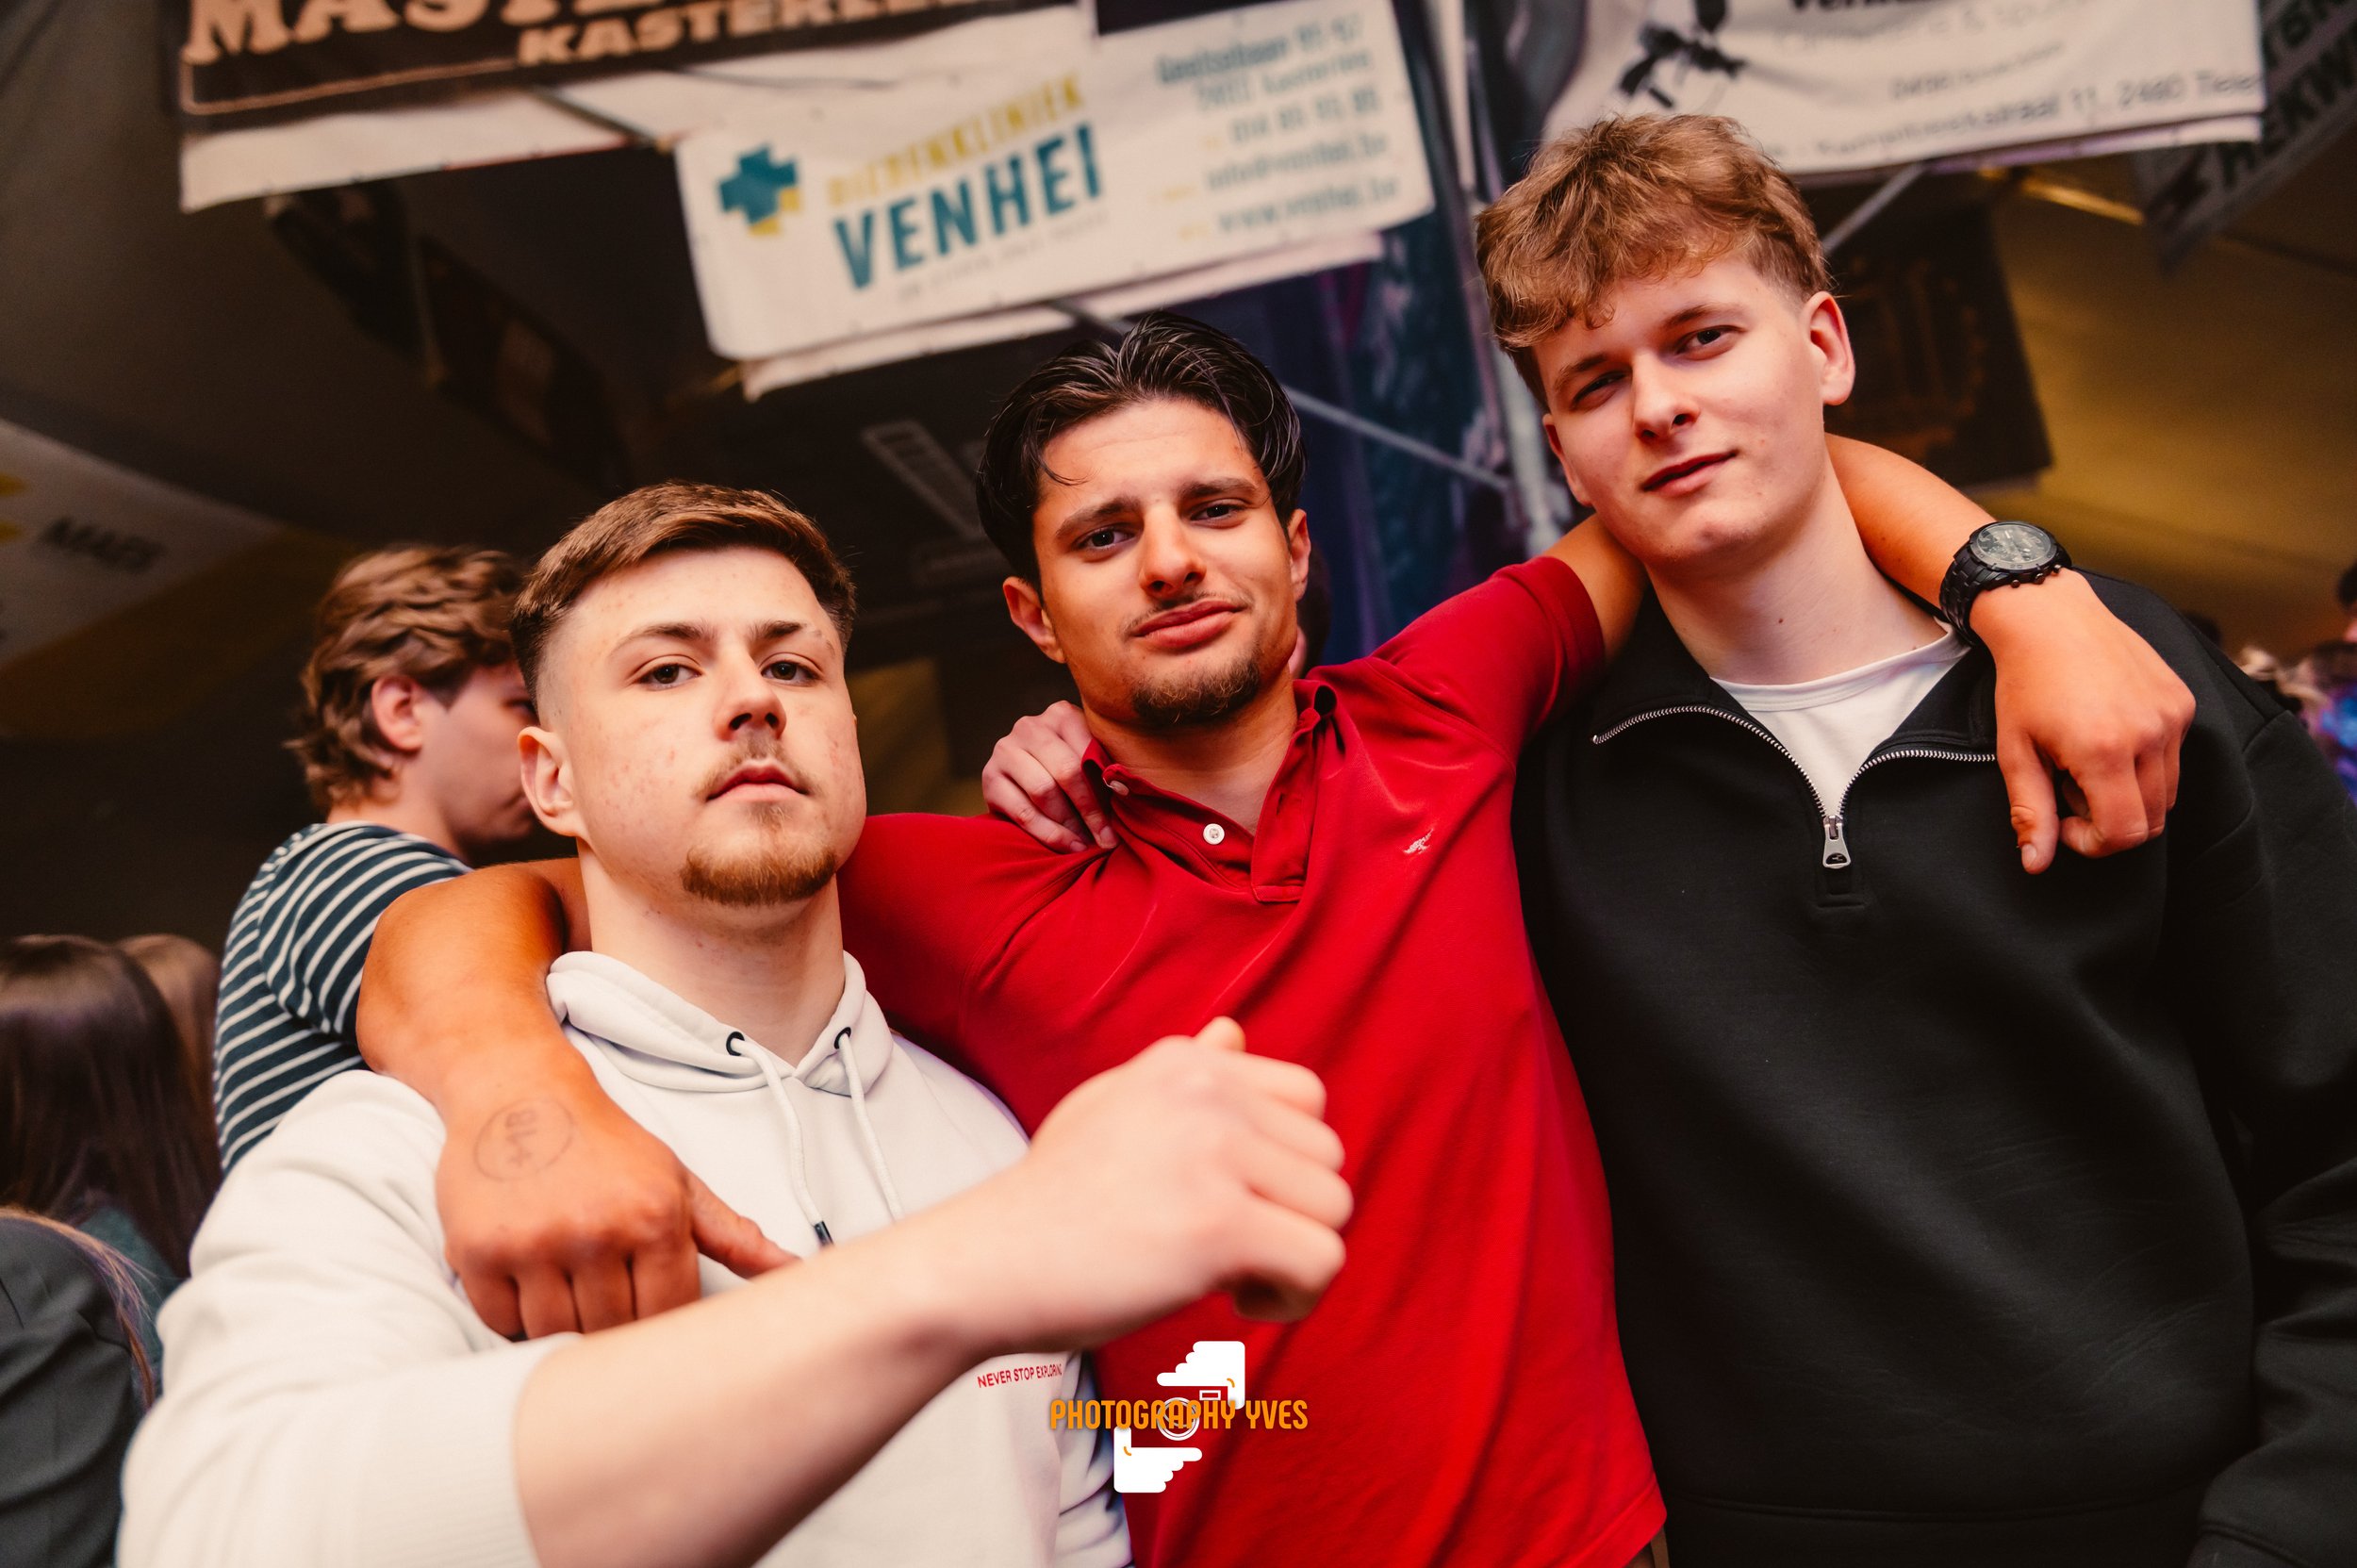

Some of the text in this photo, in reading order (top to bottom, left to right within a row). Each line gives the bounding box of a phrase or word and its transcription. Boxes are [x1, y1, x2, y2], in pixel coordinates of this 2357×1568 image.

[833, 121, 1101, 290] VENHEI
[977, 1363, 1063, 1388] NEVER STOP EXPLORIN
